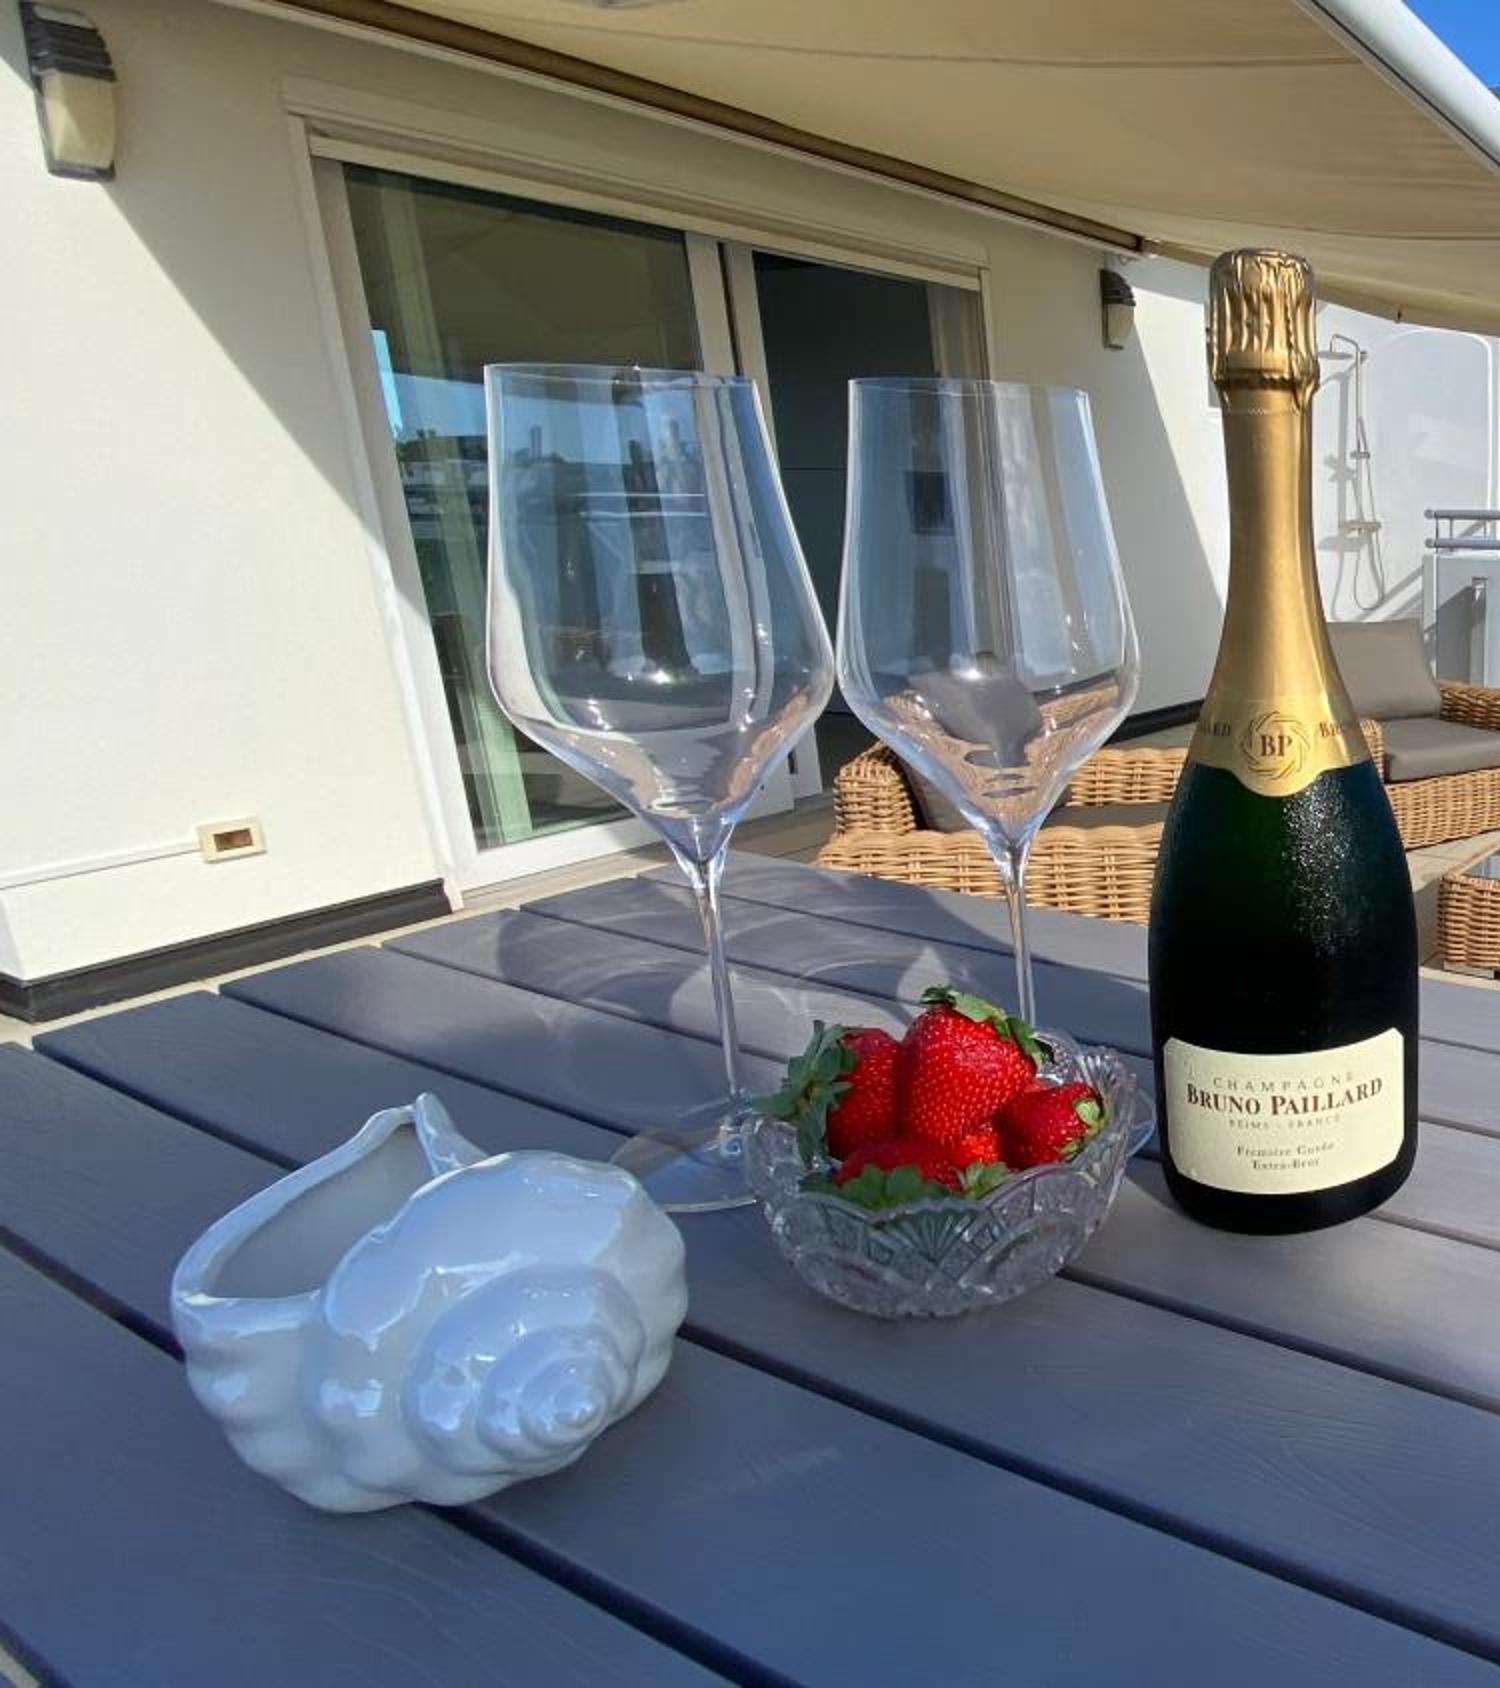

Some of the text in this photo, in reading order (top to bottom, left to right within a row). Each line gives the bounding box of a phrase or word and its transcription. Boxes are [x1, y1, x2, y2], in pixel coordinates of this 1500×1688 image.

[1260, 735, 1292, 756] BP
[1213, 1071, 1353, 1092] CHAMPAGNE
[1187, 1077, 1383, 1115] BRUNO PAILLARD
[1288, 1114, 1340, 1129] FRANCE
